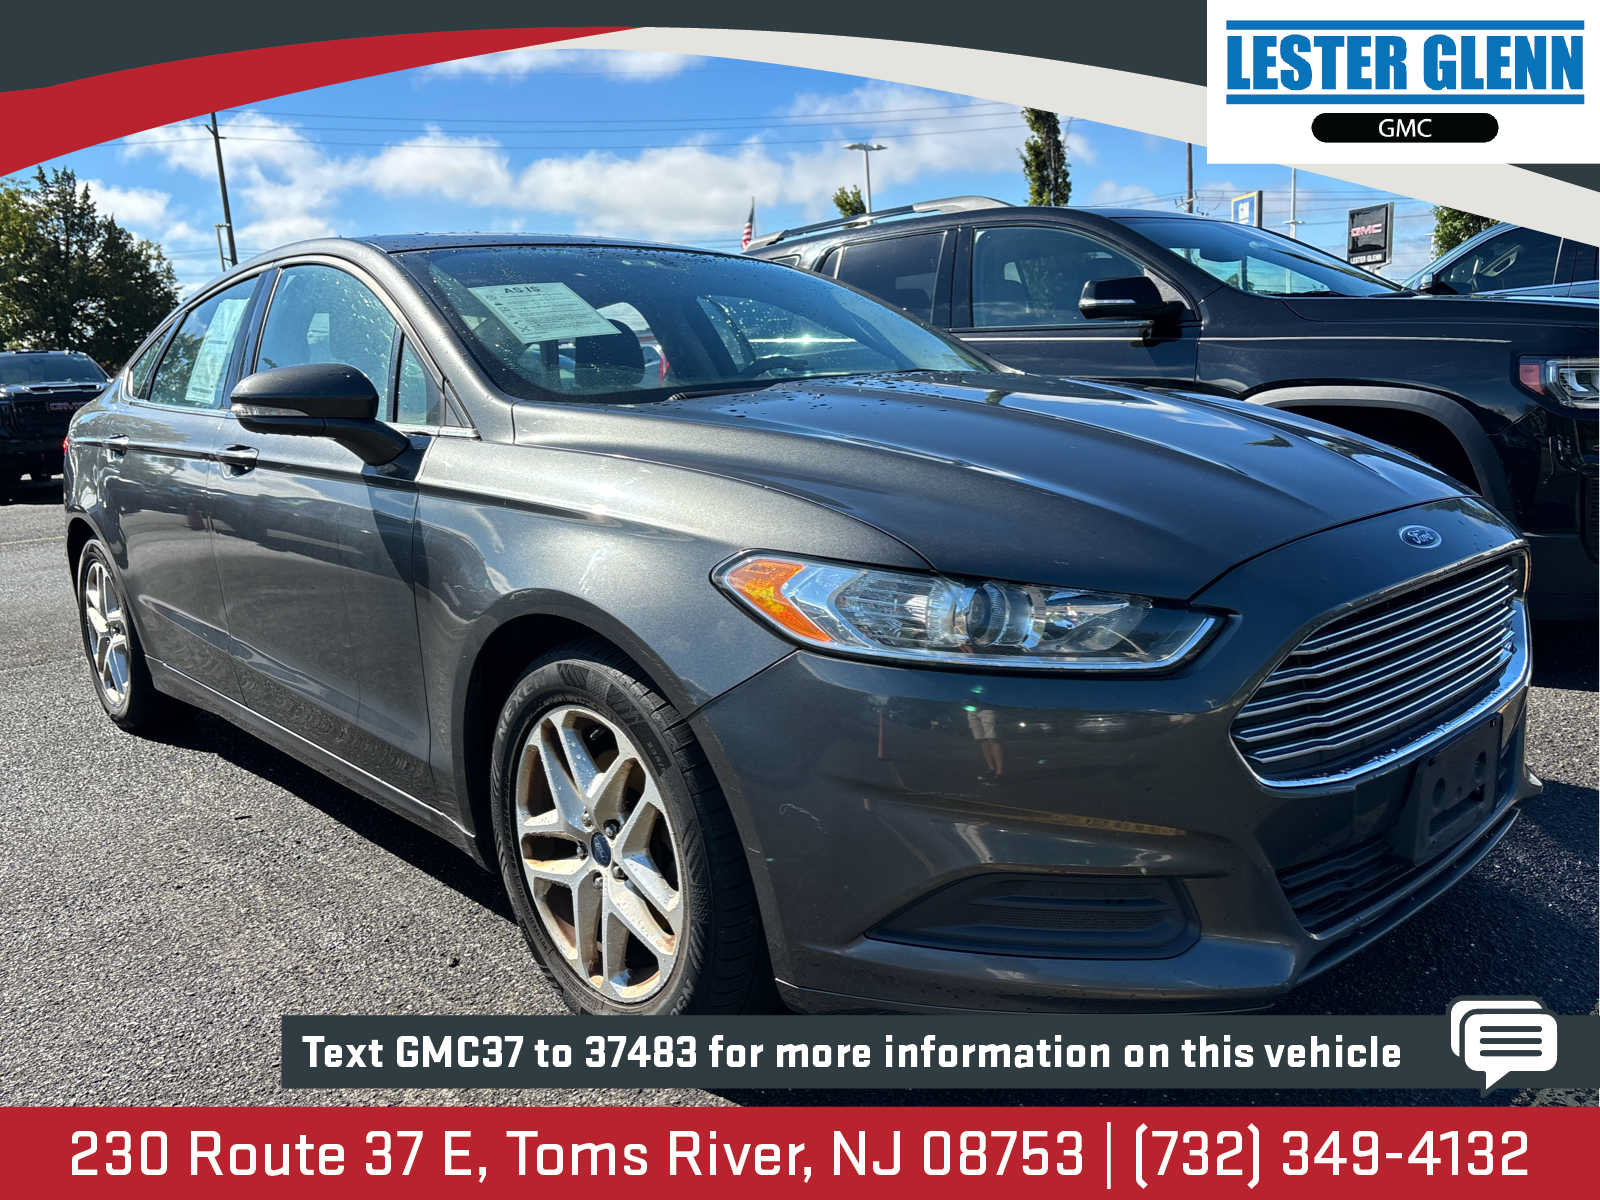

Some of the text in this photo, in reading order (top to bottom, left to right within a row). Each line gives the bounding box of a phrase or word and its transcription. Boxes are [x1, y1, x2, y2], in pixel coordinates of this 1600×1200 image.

[1350, 223, 1382, 237] GMC
[503, 285, 542, 294] AS IS
[1404, 528, 1436, 545] Ford
